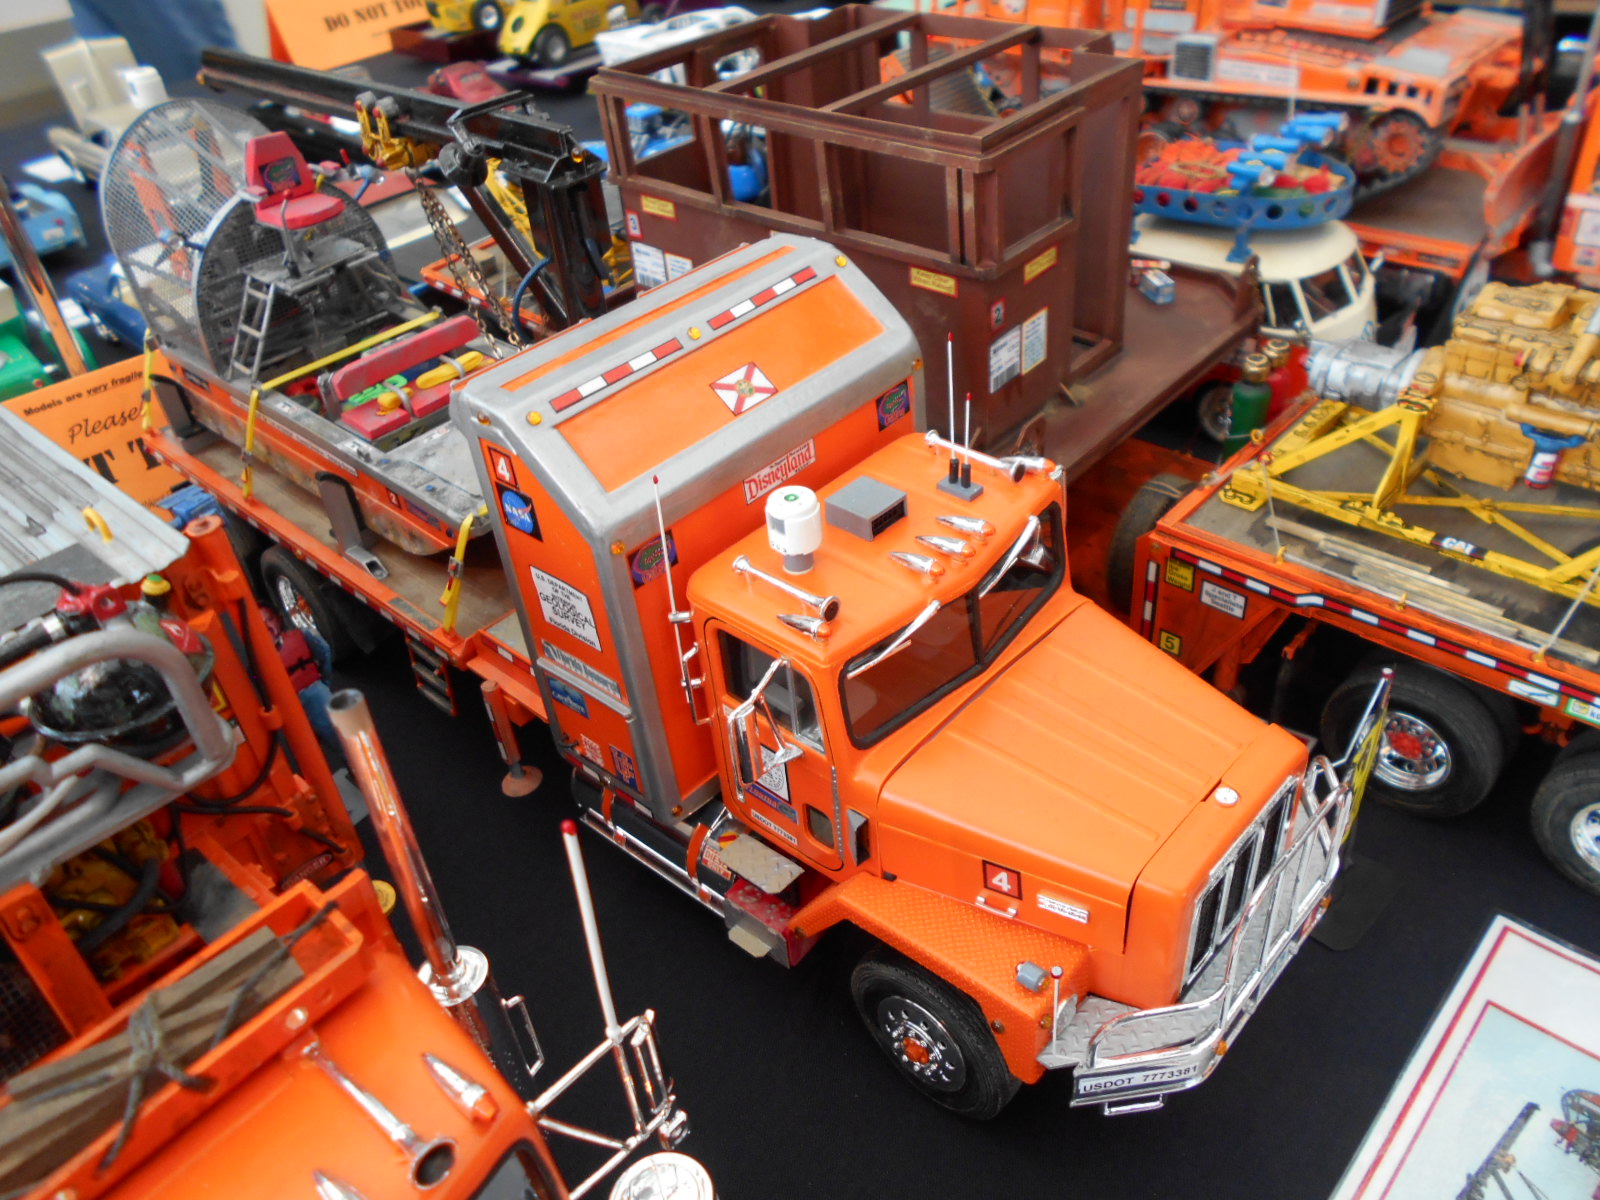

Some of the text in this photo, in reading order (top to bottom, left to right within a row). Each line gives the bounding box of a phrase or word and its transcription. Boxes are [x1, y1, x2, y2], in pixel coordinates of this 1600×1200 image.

[324, 15, 350, 31] DO
[354, 3, 387, 23] NOT
[24, 370, 144, 416] Models are very fragile
[498, 457, 510, 482] 4
[745, 443, 812, 500] Disneyland
[504, 503, 531, 522] NASA
[1442, 536, 1475, 555] CAT
[538, 591, 595, 629] GEOLOGICAL
[551, 605, 587, 631] SURVEY
[548, 616, 596, 647] Florida Division
[1164, 635, 1176, 650] 5
[992, 872, 1012, 892] 4
[1083, 1065, 1198, 1092] USDOT 7773381
